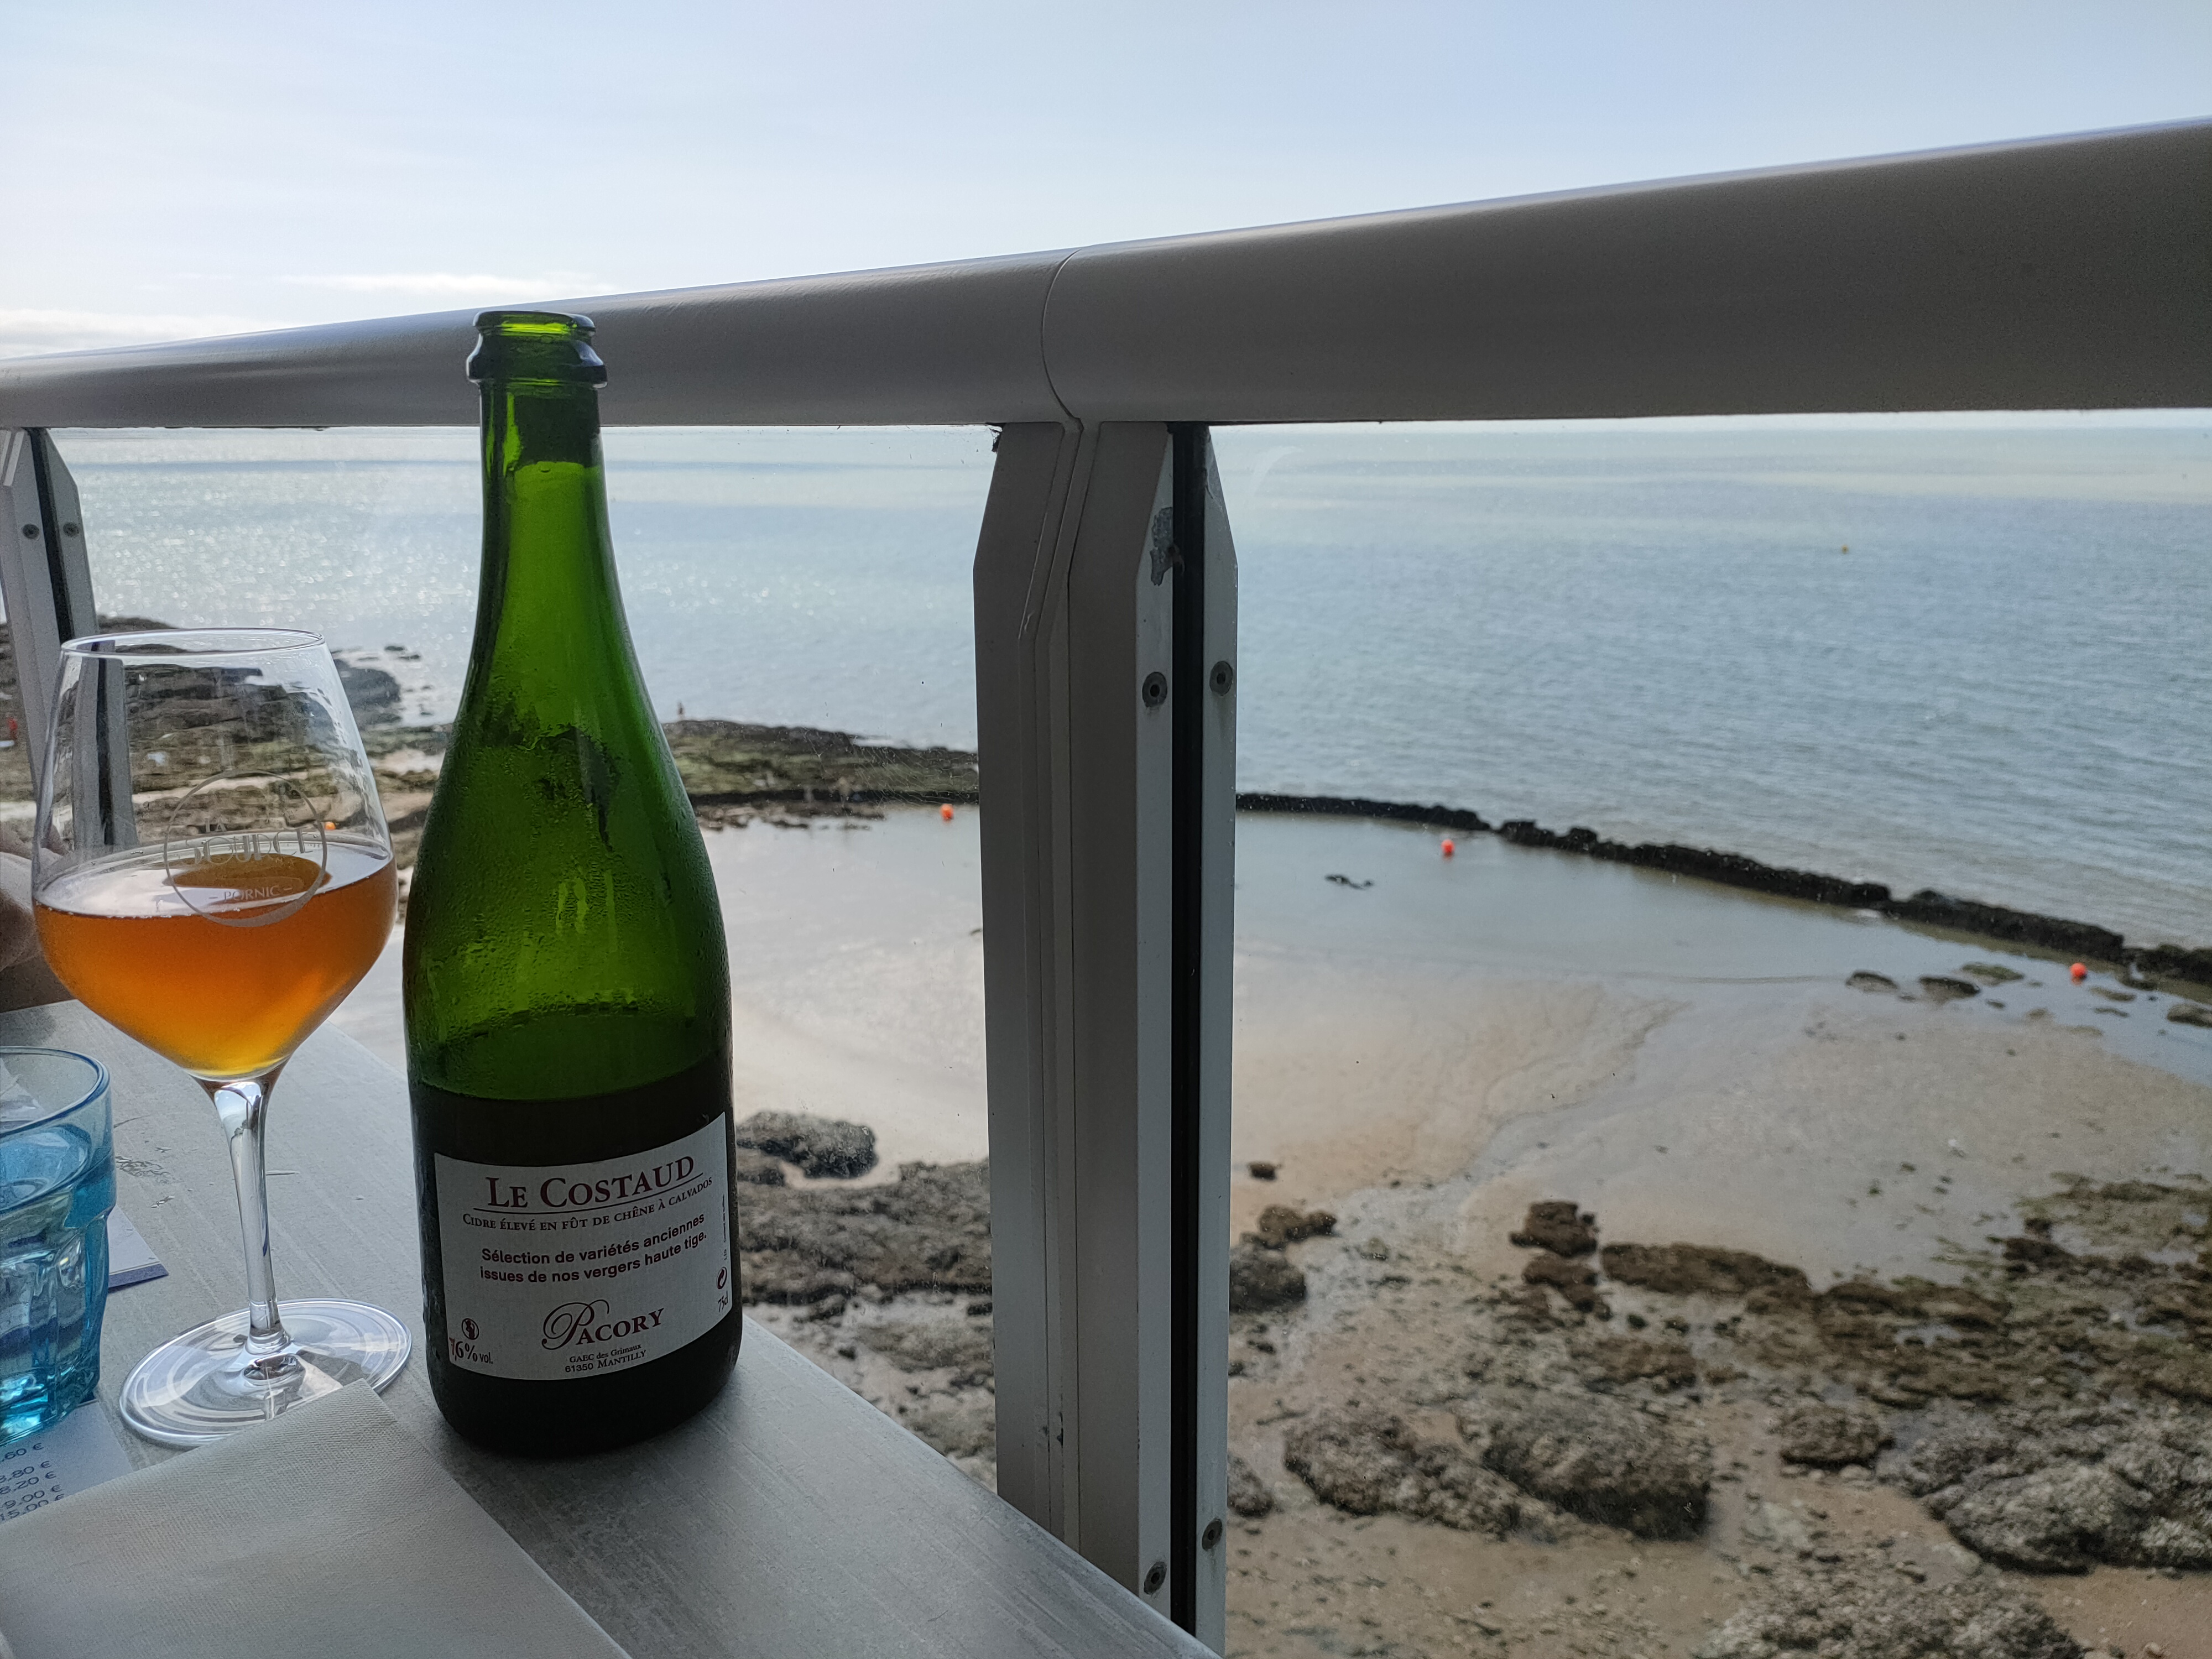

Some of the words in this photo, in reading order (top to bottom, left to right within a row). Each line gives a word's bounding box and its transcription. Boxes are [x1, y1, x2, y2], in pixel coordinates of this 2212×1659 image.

[223, 885, 281, 901] PORNIC
[486, 1177, 528, 1208] LE
[540, 1156, 694, 1208] COSTAUD
[463, 1213, 496, 1229] CIDRE
[500, 1218, 536, 1231] ÉLEVÉ
[540, 1222, 557, 1230] EN
[562, 1217, 588, 1229] FÛT
[592, 1215, 610, 1226] DE
[614, 1204, 655, 1222] CHÊNE
[658, 1198, 666, 1211] À
[668, 1176, 712, 1206] CALVADOS
[482, 1248, 550, 1264] Sélection
[555, 1250, 575, 1263] de
[579, 1240, 639, 1261] variétés
[643, 1214, 705, 1248] anciennes
[480, 1266, 524, 1282] issues
[528, 1270, 547, 1282] de
[552, 1271, 580, 1282] nos
[584, 1259, 640, 1278] vergers
[645, 1245, 681, 1266] haute
[684, 1232, 707, 1249] tige.
[541, 1299, 664, 1350] PACORY
[479, 1352, 494, 1365] vol.
[565, 1363, 593, 1373] 61350
[597, 1349, 646, 1369] MANTILLY
[569, 1354, 594, 1363] GAEC
[596, 1351, 609, 1359] des
[611, 1344, 641, 1357] Grimaux
[32, 1442, 44, 1451] €
[40, 1460, 53, 1469] €
[45, 1470, 57, 1479] €
[51, 1484, 62, 1493] €
